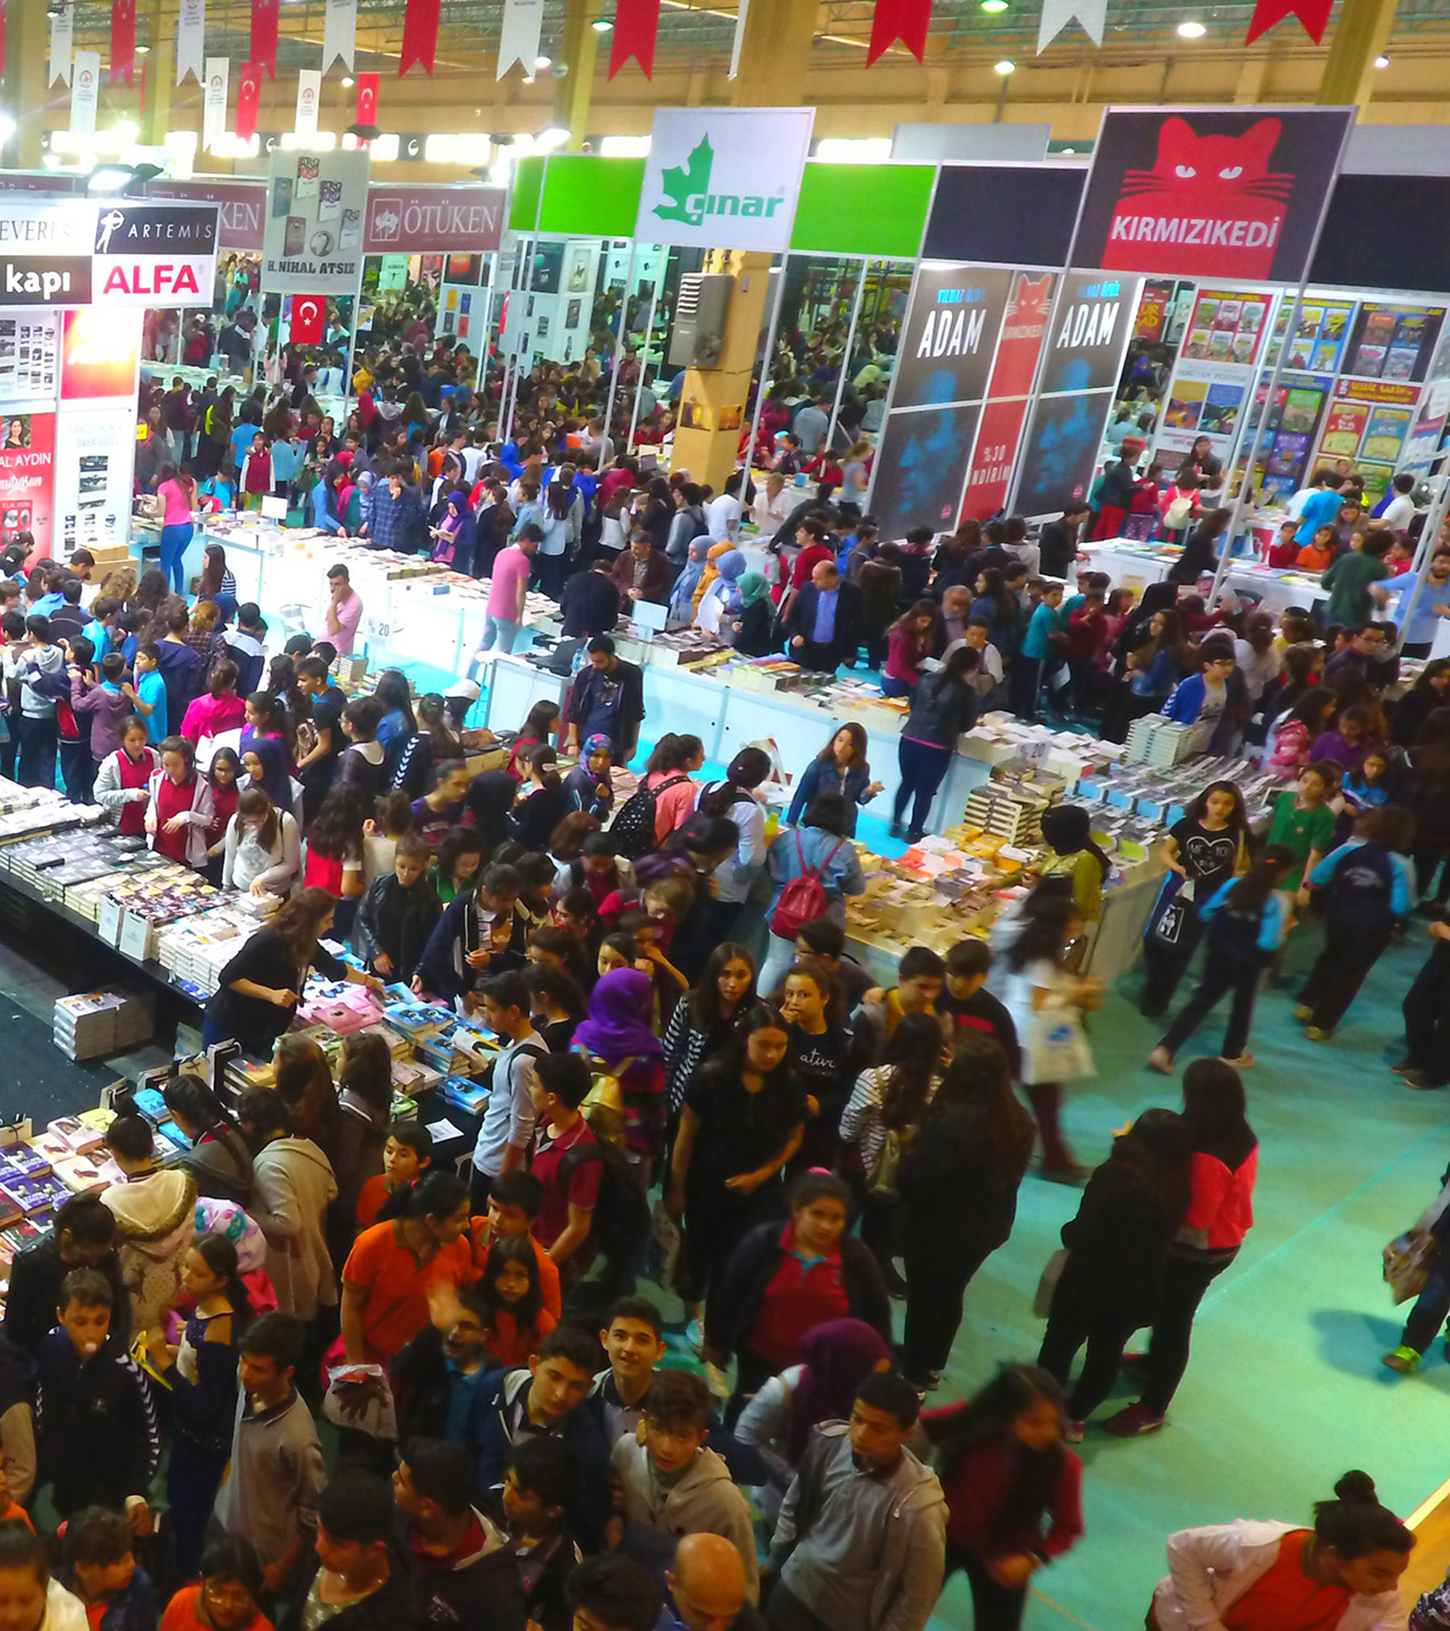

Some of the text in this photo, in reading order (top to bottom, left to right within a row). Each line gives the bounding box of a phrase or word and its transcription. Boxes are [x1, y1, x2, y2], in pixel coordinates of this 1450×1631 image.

[404, 199, 498, 234] ÖTÜKEN
[685, 193, 784, 222] çınar
[128, 224, 212, 240] ARTEMİS
[1111, 216, 1281, 248] KIRMIZIKEDİ
[6, 264, 71, 300] kapı
[103, 264, 200, 294] ALFA
[278, 260, 316, 274] NİHAL
[319, 263, 355, 274] ATSIZ
[916, 308, 987, 359] ADAM
[1056, 302, 1120, 349] ADAM
[14, 452, 51, 466] AYDIN
[971, 464, 1011, 485] NDİRİM
